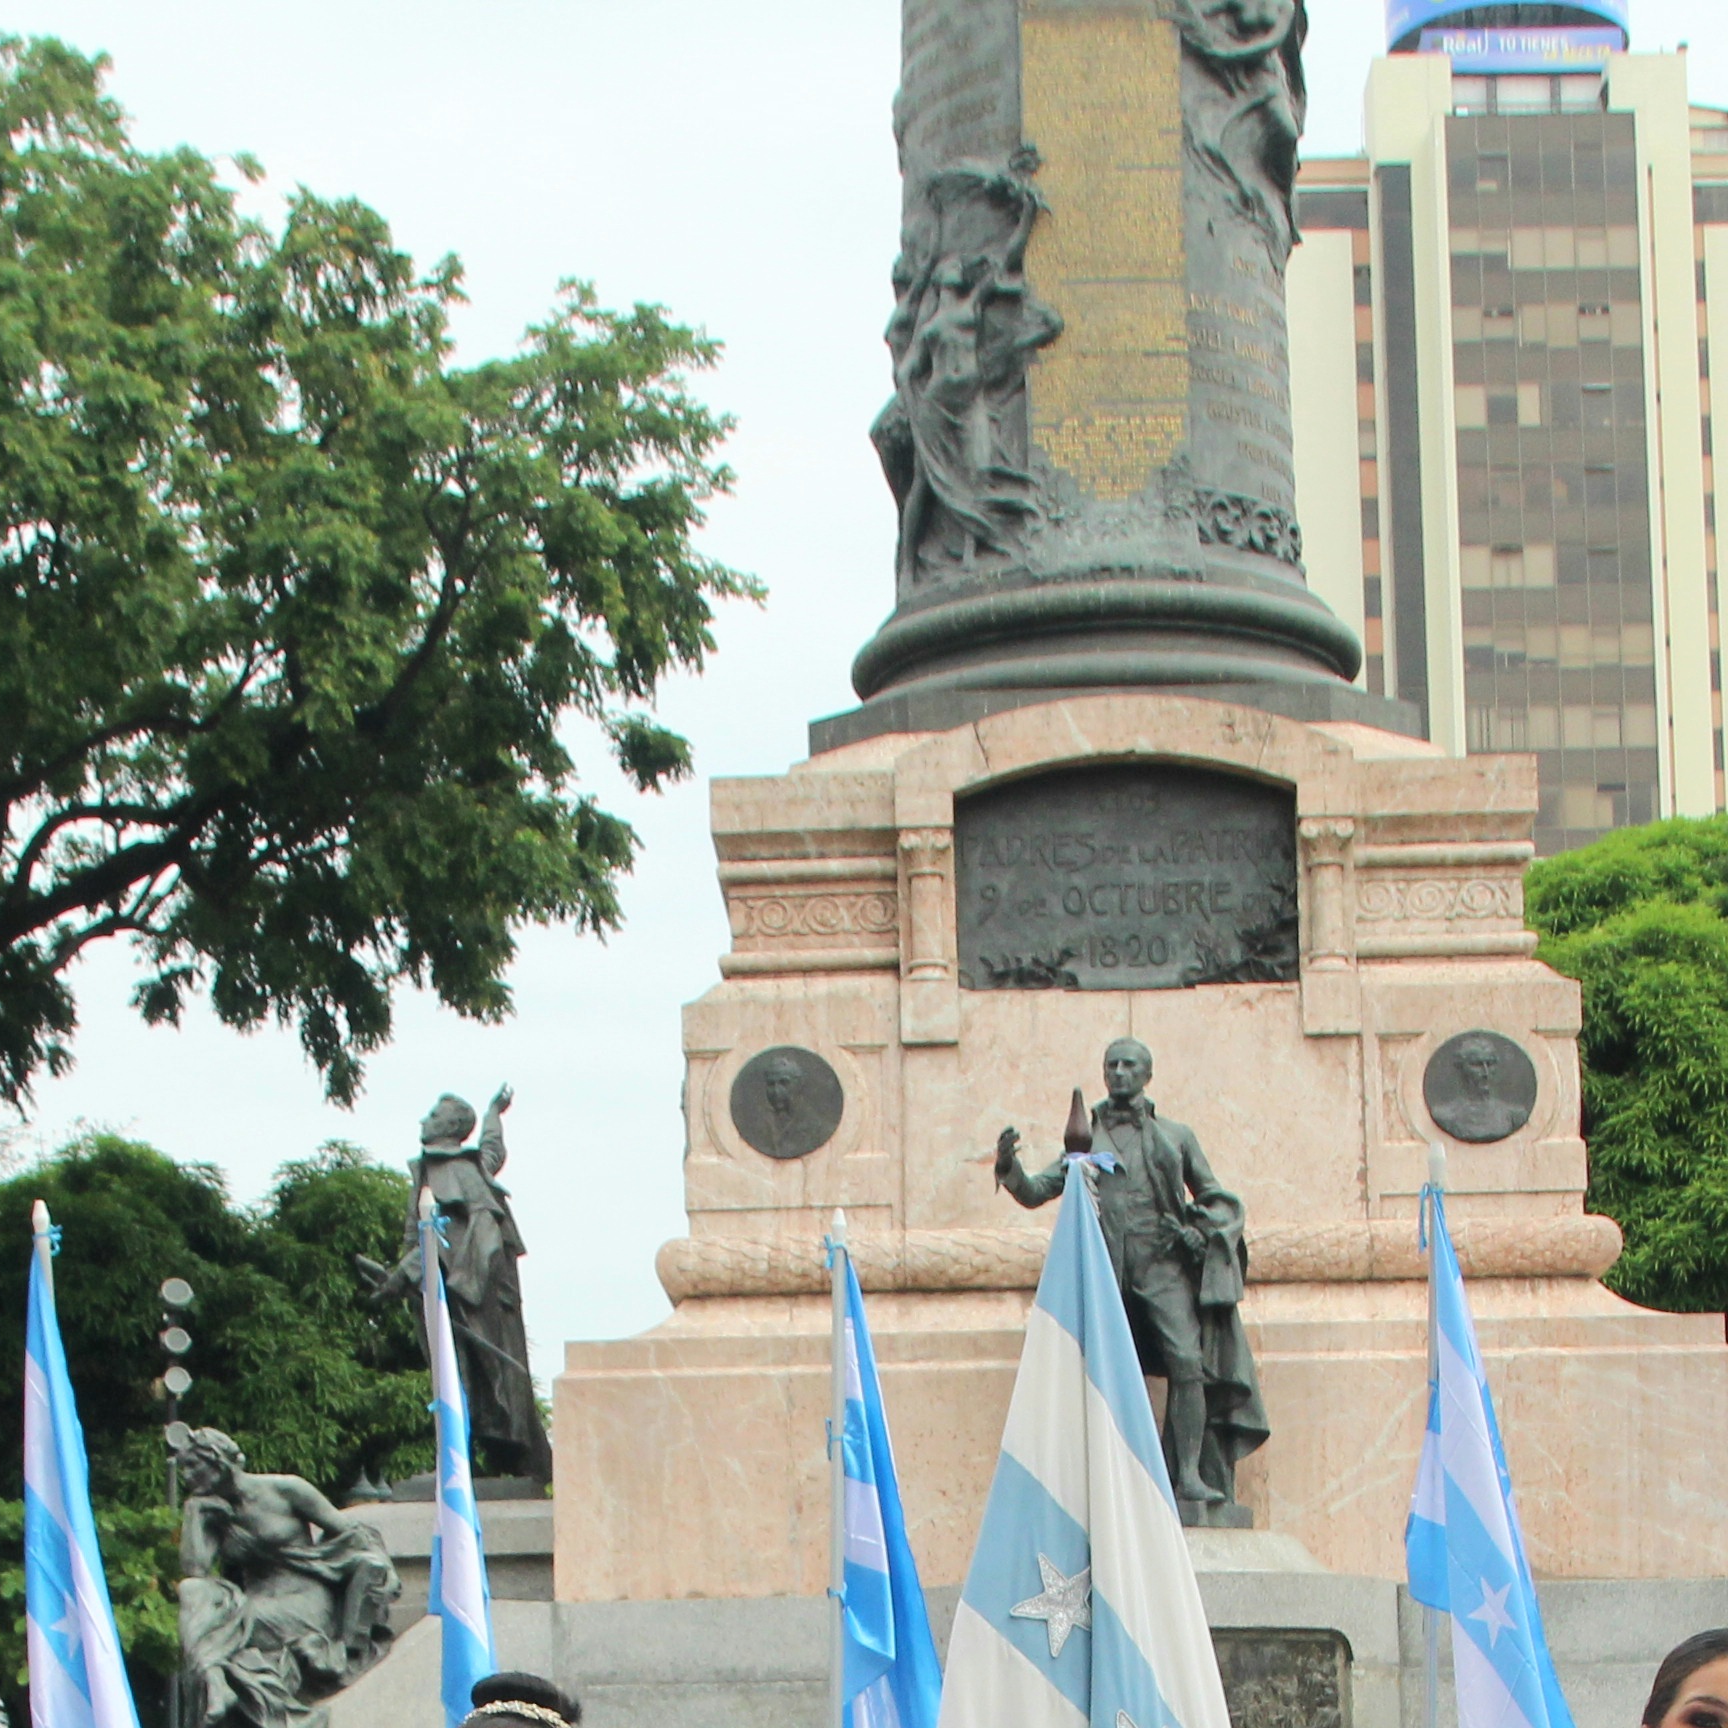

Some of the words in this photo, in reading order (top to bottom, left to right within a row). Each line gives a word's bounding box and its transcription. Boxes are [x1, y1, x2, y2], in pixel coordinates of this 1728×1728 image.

[961, 832, 1097, 872] PADRES
[978, 883, 1002, 927] 9
[1061, 879, 1233, 923] OCTUBRE
[1087, 933, 1171, 969] 1820
